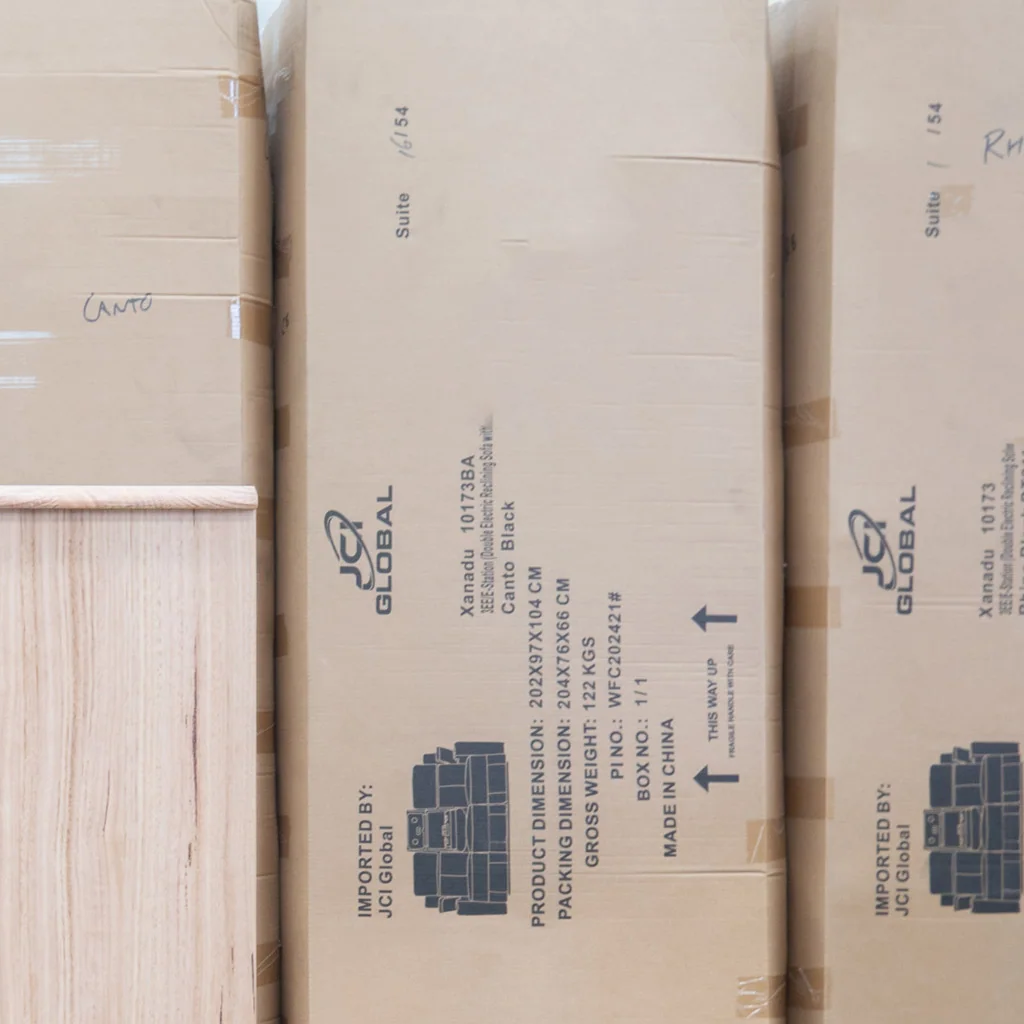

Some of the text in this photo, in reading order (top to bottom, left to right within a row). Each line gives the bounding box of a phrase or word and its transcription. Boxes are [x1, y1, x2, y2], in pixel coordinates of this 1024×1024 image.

[396, 193, 409, 238] Suite
[480, 443, 493, 460] Sofa
[480, 500, 494, 528] Electric
[481, 462, 496, 498] Reclining
[376, 485, 392, 615] GLOBAL
[460, 455, 475, 617] Xanadu 10173BA
[501, 502, 515, 614] Canto Black
[895, 486, 916, 615] GLOBAL
[979, 483, 995, 617] Xanadu 10173
[528, 567, 545, 927] PRODUCT DIMENSION: 202X97X104 CM
[556, 579, 572, 919] PACKING DIMENSION: 204X76X66 CM
[608, 592, 623, 779] PI NO.: WFC202421#
[636, 720, 649, 756] NO.:
[707, 658, 718, 741] THIS WAY UP
[582, 637, 599, 867] GROSS WEIGHT: 122 KGS
[637, 763, 650, 801] BOX
[661, 719, 676, 857] MADE IN CHINA
[358, 785, 372, 917] IMPORTED BY:
[379, 826, 393, 918] JCI Global
[875, 784, 890, 915] IMPORTED BY:
[895, 825, 910, 916] JCI Global
